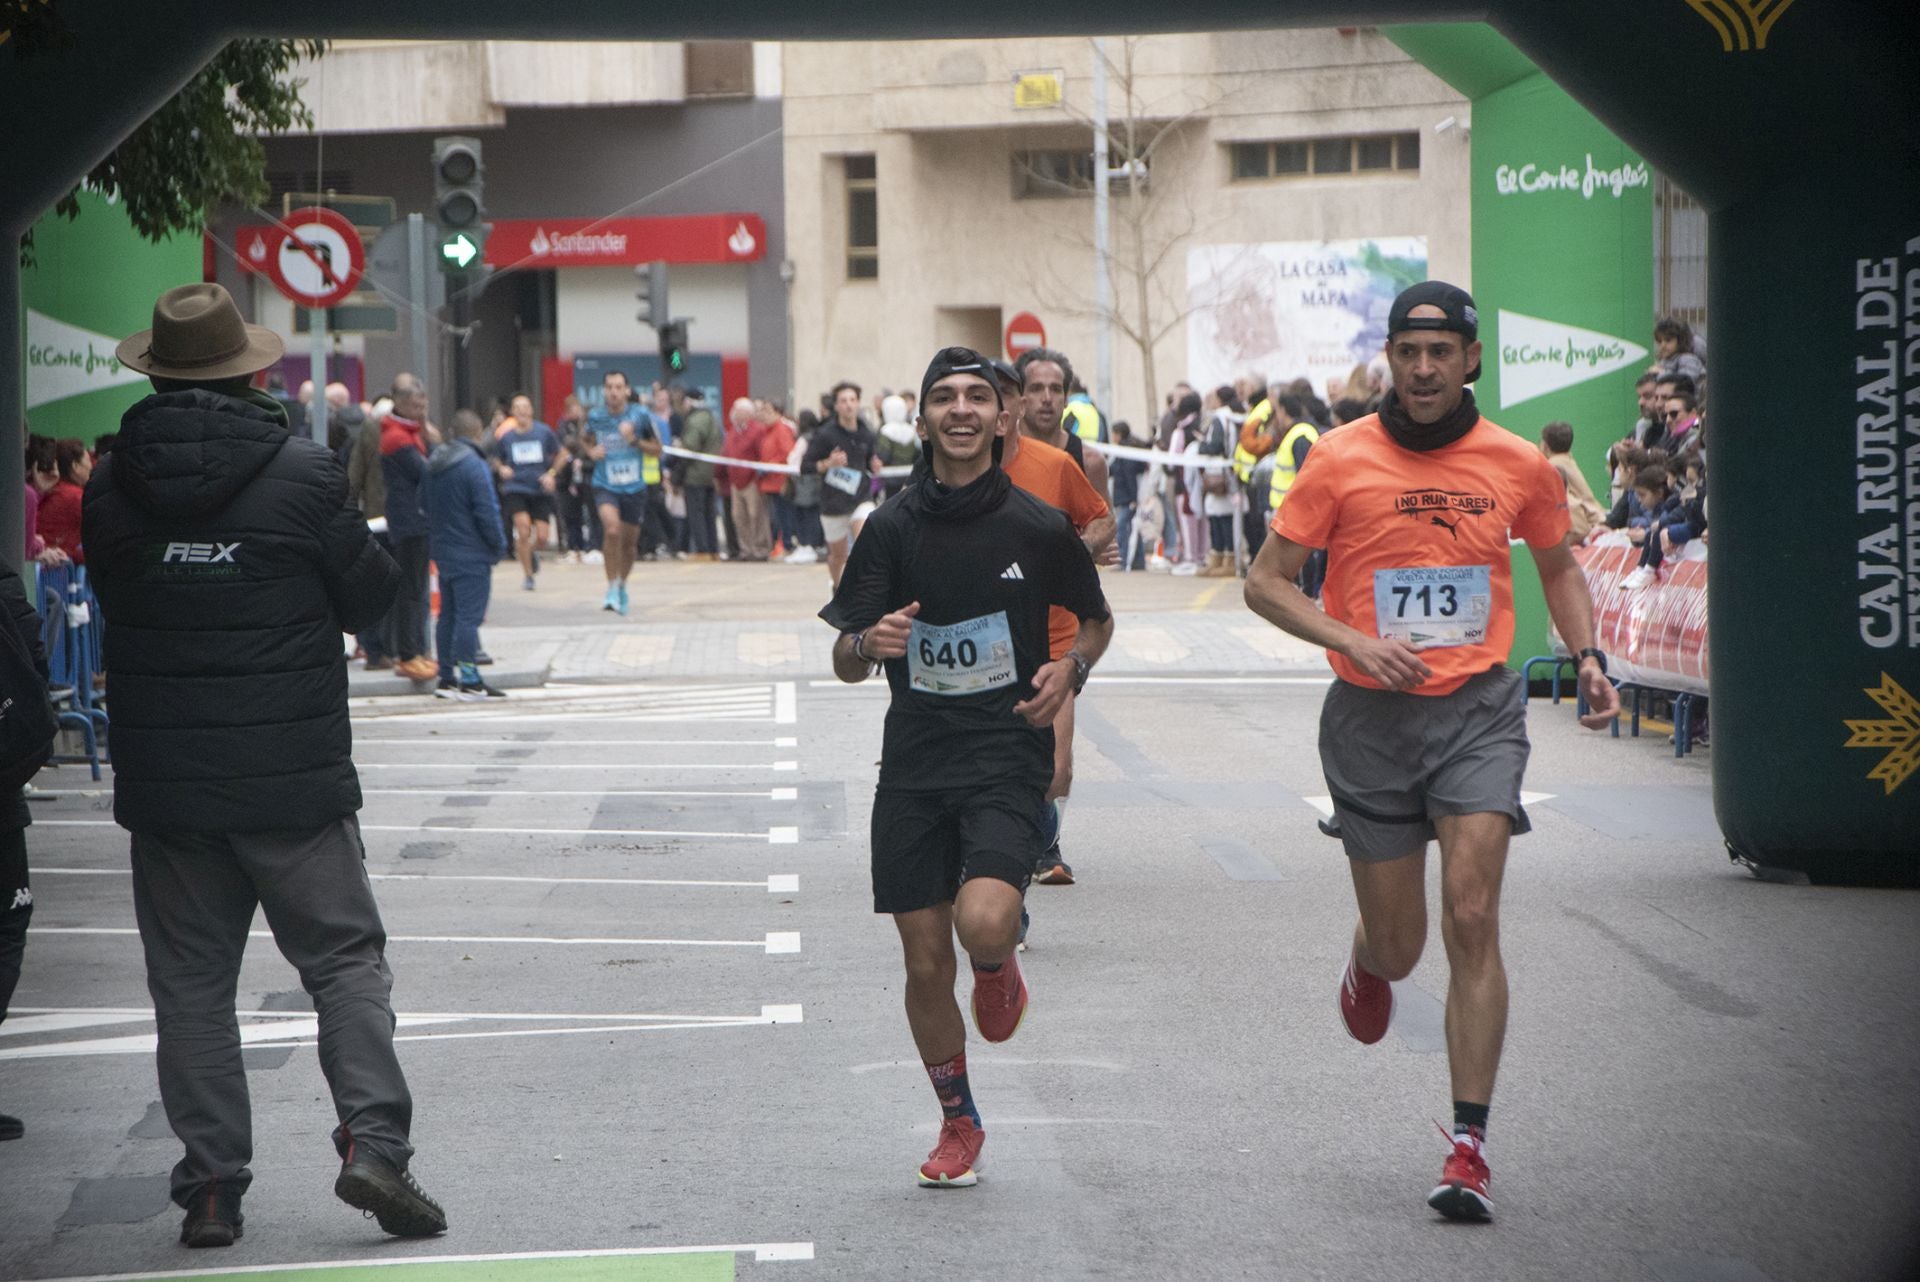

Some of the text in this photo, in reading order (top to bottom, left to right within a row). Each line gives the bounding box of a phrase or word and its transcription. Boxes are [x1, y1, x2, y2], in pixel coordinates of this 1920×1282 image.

[1496, 153, 1649, 199] El Corte Inglés
[551, 231, 628, 257] Santander
[1281, 260, 1347, 277] LA CASA
[1302, 290, 1348, 306] MAPA
[43, 346, 82, 367] Corte
[85, 341, 120, 375] Ing
[1503, 336, 1625, 368] El Corte Inglés
[1856, 257, 1903, 648] CAJA RURAL DE
[1400, 495, 1418, 507] NO
[1422, 494, 1448, 506] RUN
[1392, 584, 1458, 618] 713
[1465, 630, 1483, 638] HOY
[920, 638, 977, 669] 640
[988, 671, 1011, 683] HOY
